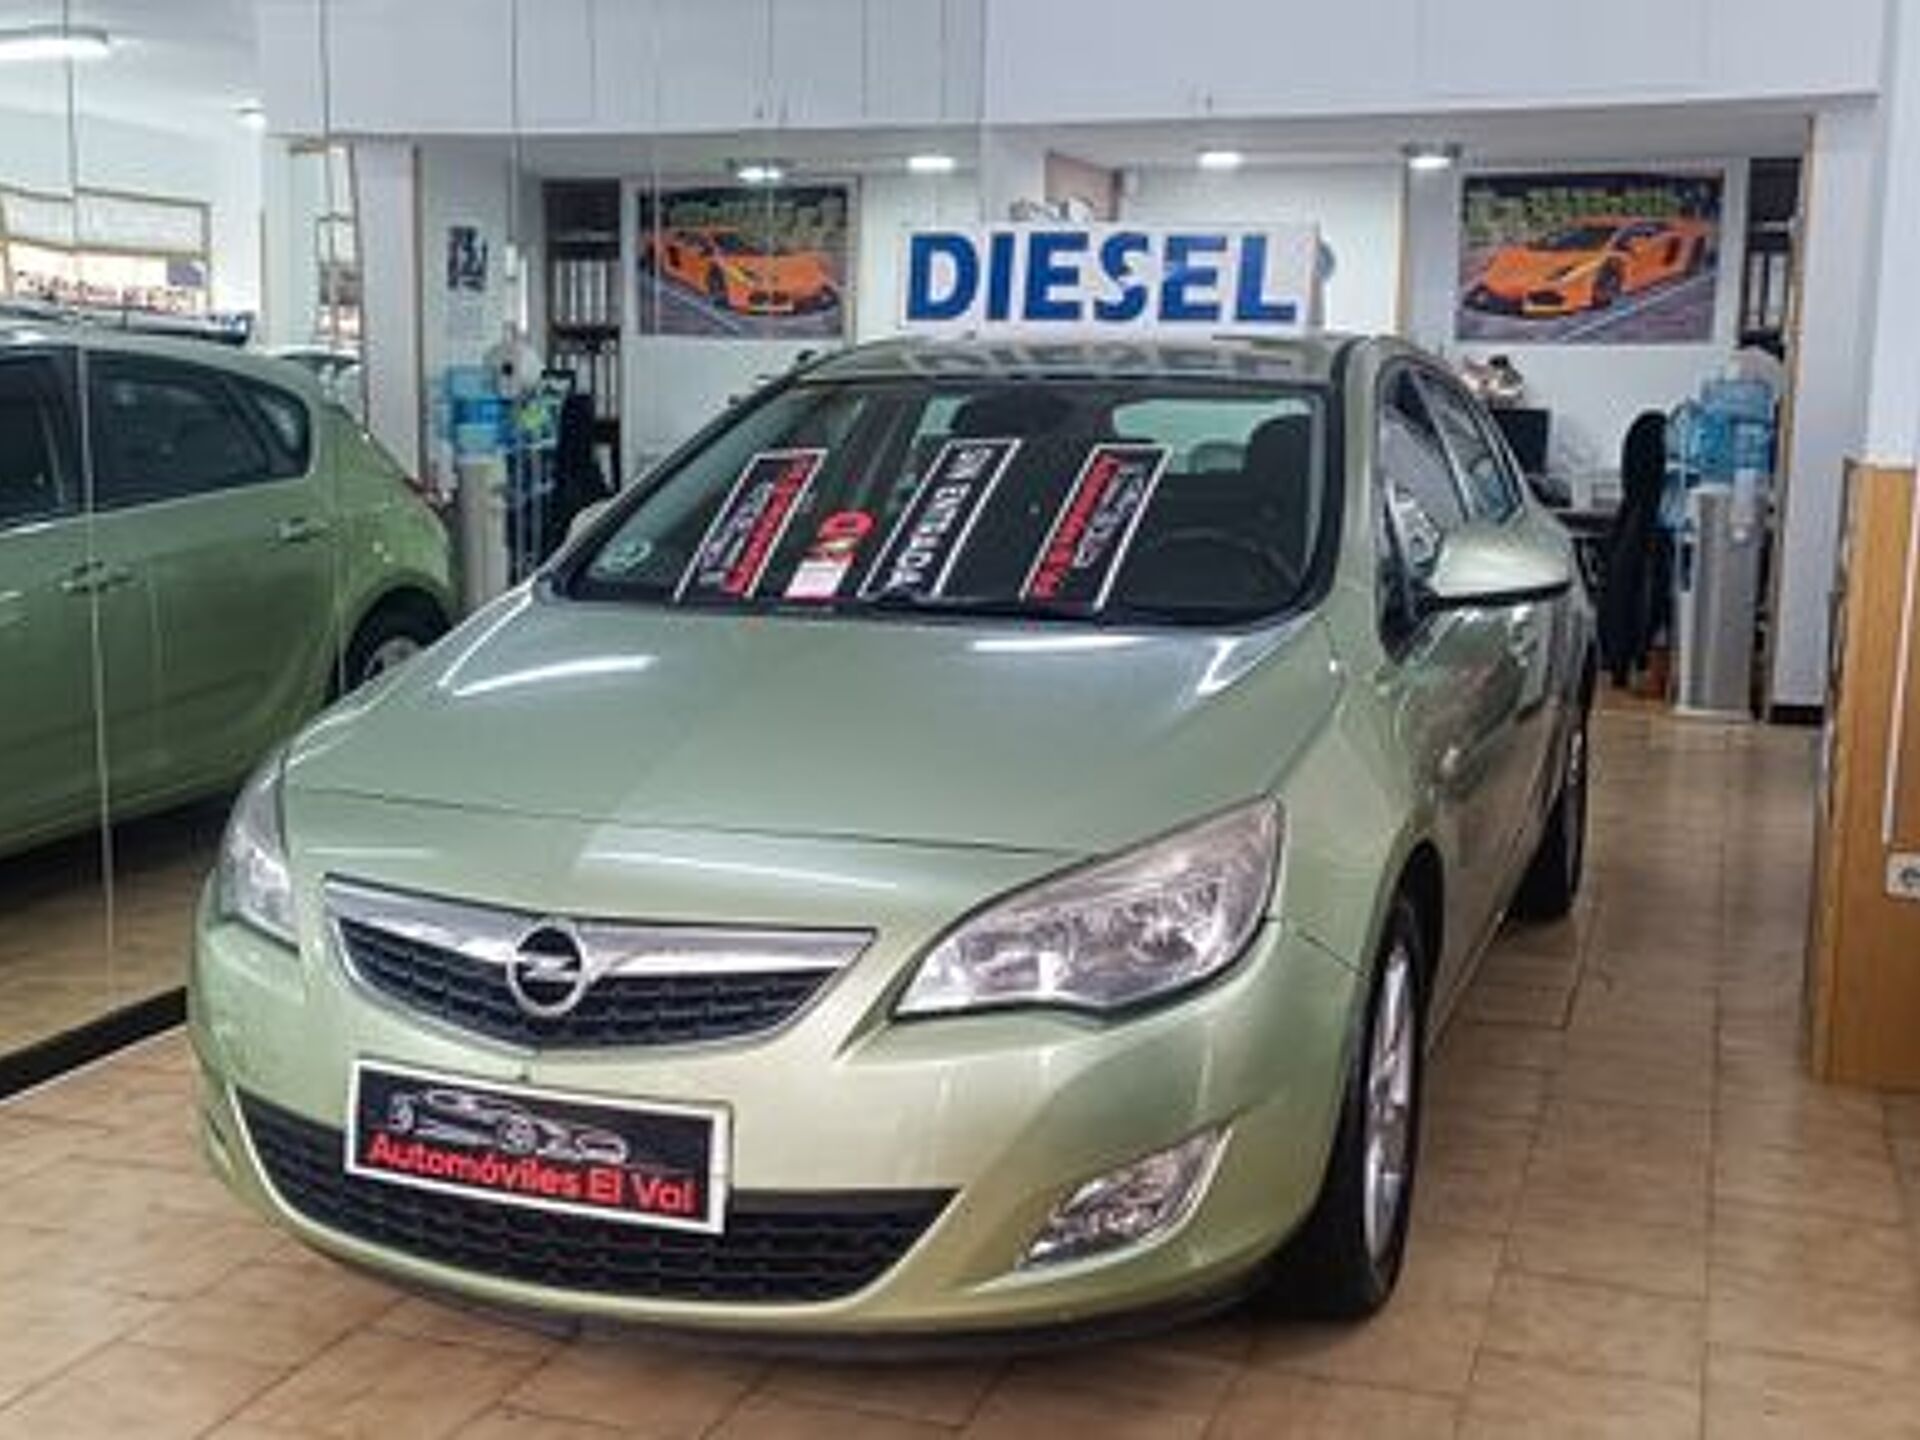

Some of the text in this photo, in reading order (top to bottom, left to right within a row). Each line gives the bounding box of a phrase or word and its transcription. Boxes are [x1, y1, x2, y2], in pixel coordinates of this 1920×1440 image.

[907, 231, 1297, 322] DIESEL
[369, 1133, 580, 1196] Automóviles
[589, 1167, 621, 1204] El
